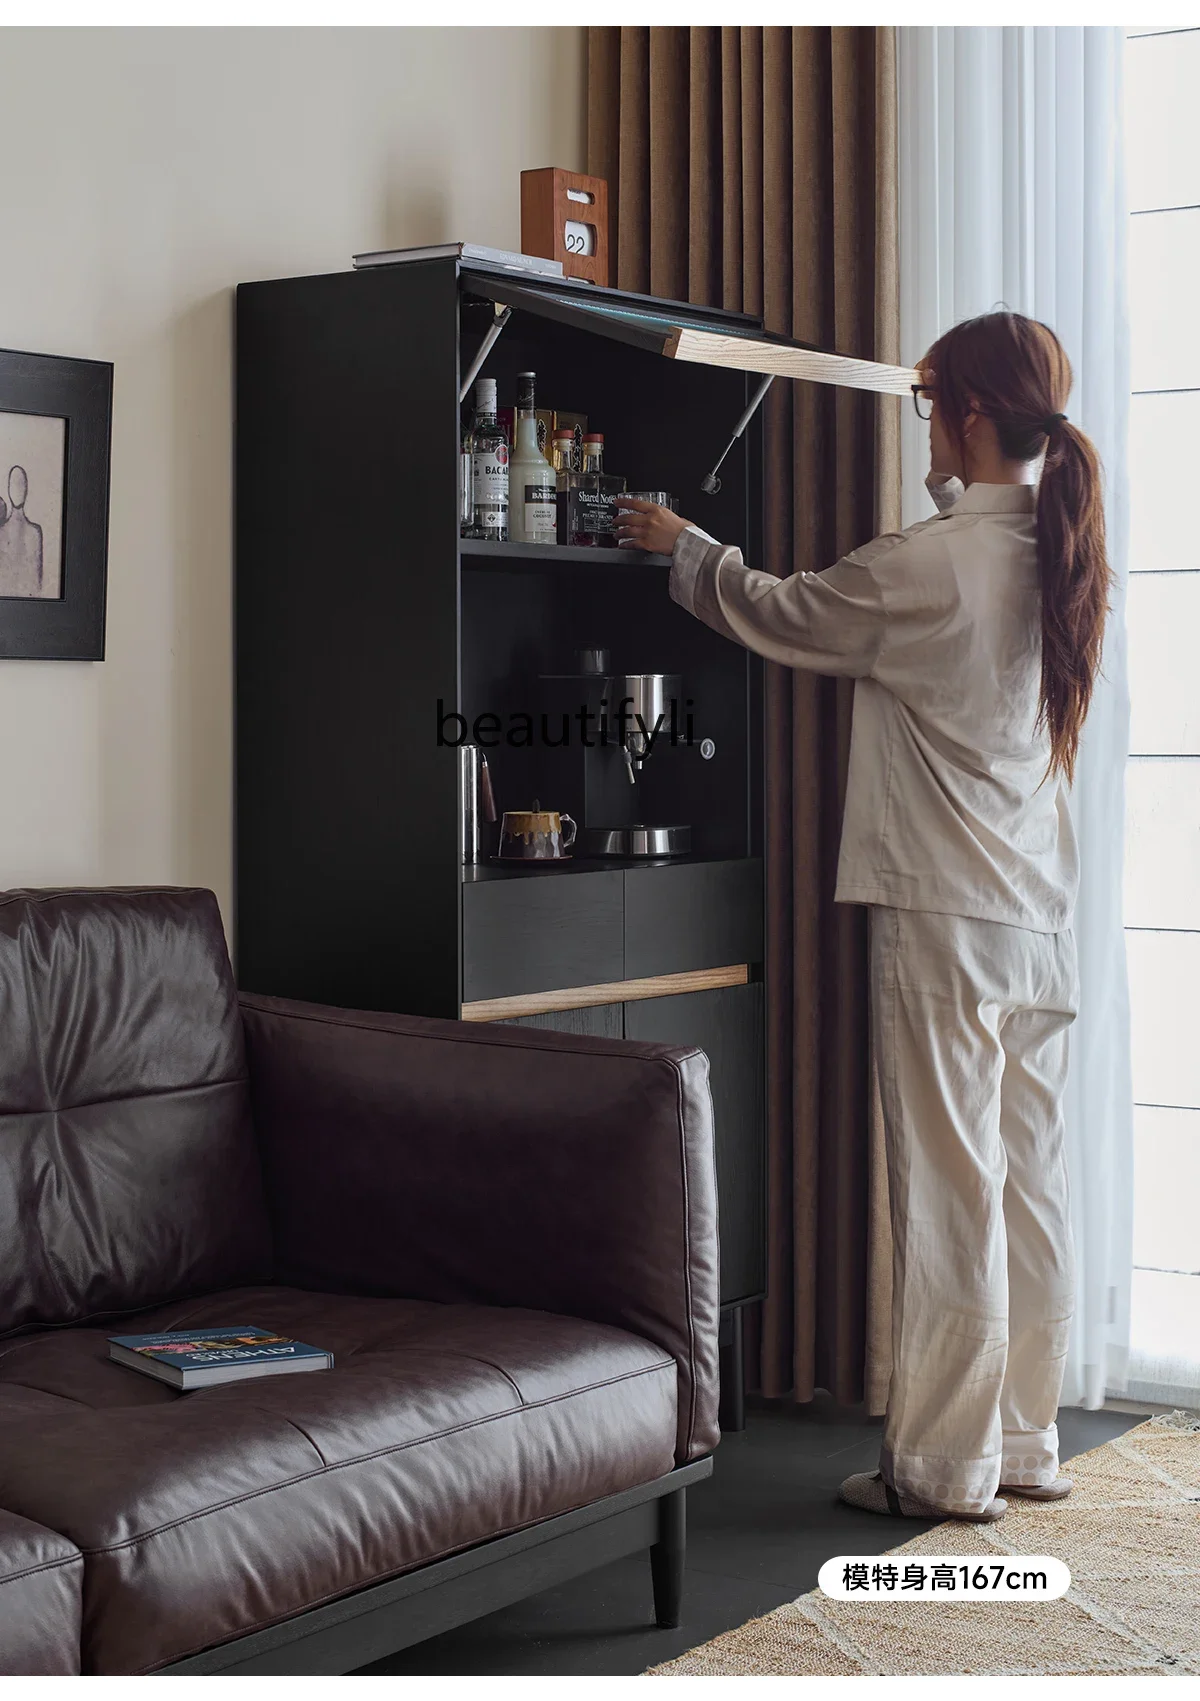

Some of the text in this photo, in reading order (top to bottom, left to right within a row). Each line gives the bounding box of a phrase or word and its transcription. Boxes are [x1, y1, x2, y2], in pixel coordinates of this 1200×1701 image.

[567, 234, 585, 254] 22
[578, 491, 599, 503] Shared
[192, 1346, 295, 1361] ATHENS
